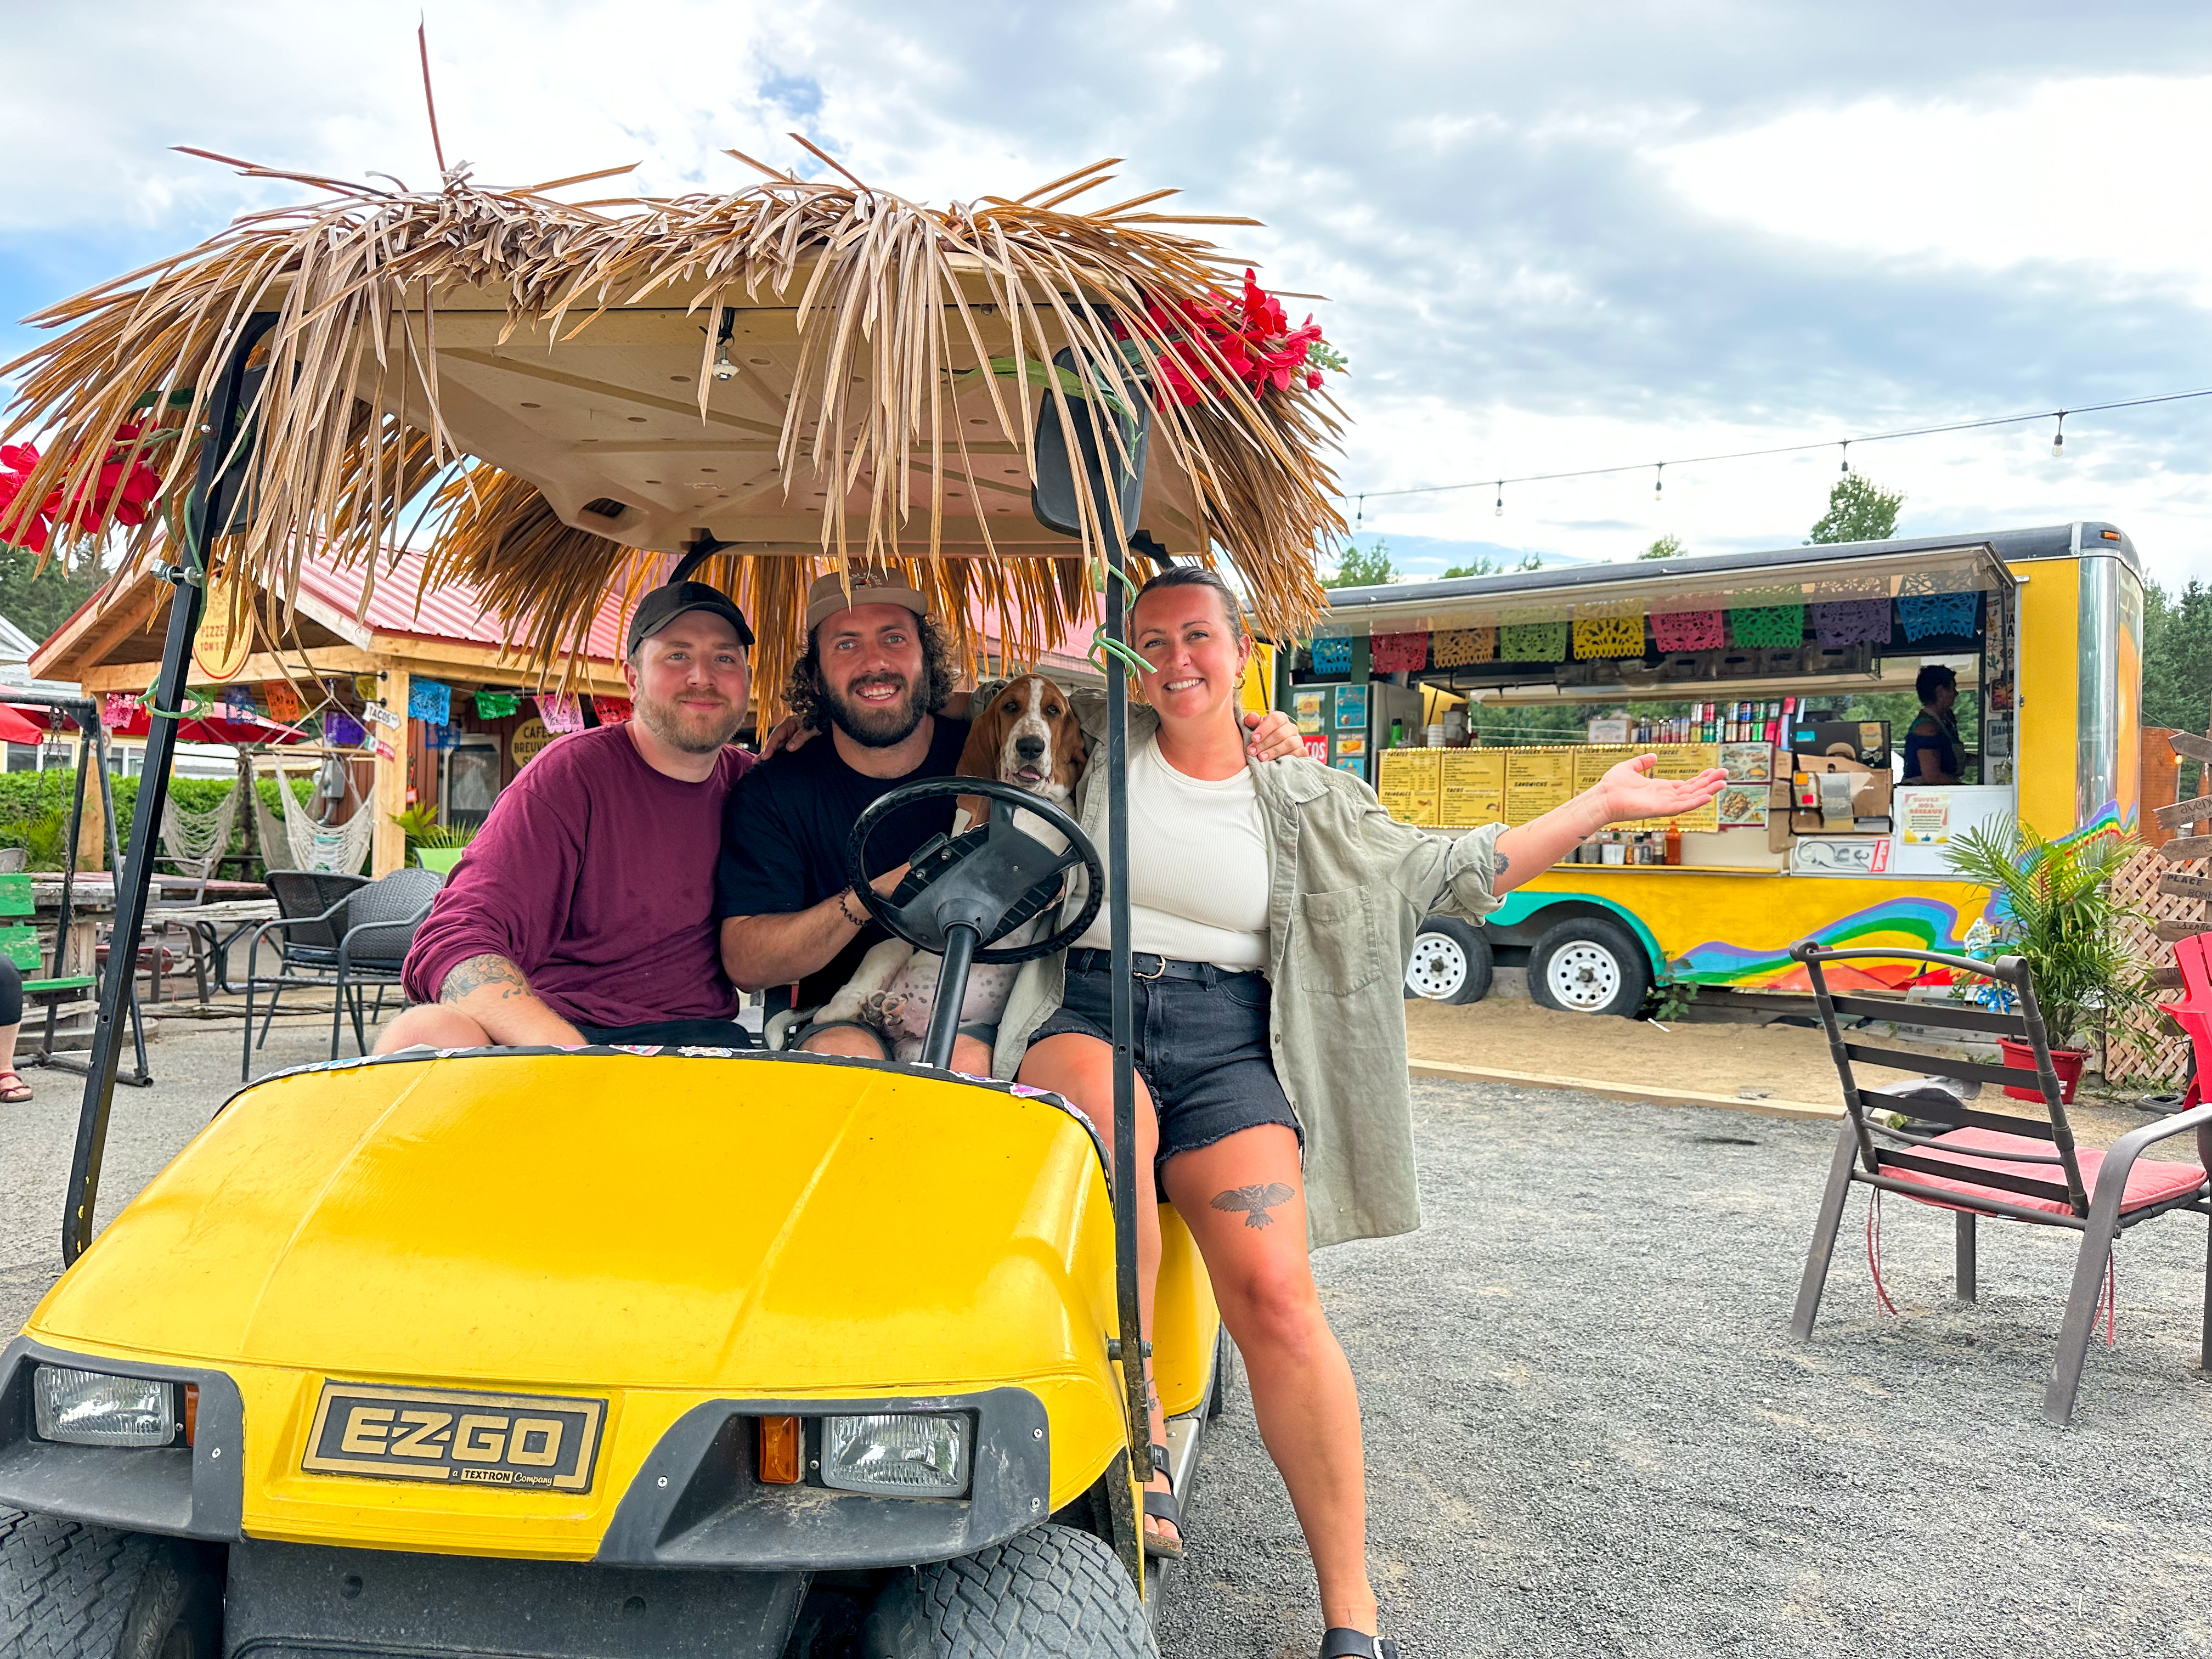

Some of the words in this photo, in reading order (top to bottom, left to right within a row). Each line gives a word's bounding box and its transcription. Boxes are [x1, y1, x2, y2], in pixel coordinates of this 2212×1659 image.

[370, 705, 391, 723] TACOS
[523, 726, 554, 738] CAFE
[1306, 741, 1325, 759] COS
[2168, 874, 2202, 886] PLACE
[2167, 968, 2179, 977] RO
[341, 1406, 563, 1466] EZGO
[465, 1470, 511, 1482] TEXTRON
[514, 1472, 553, 1486] Company
